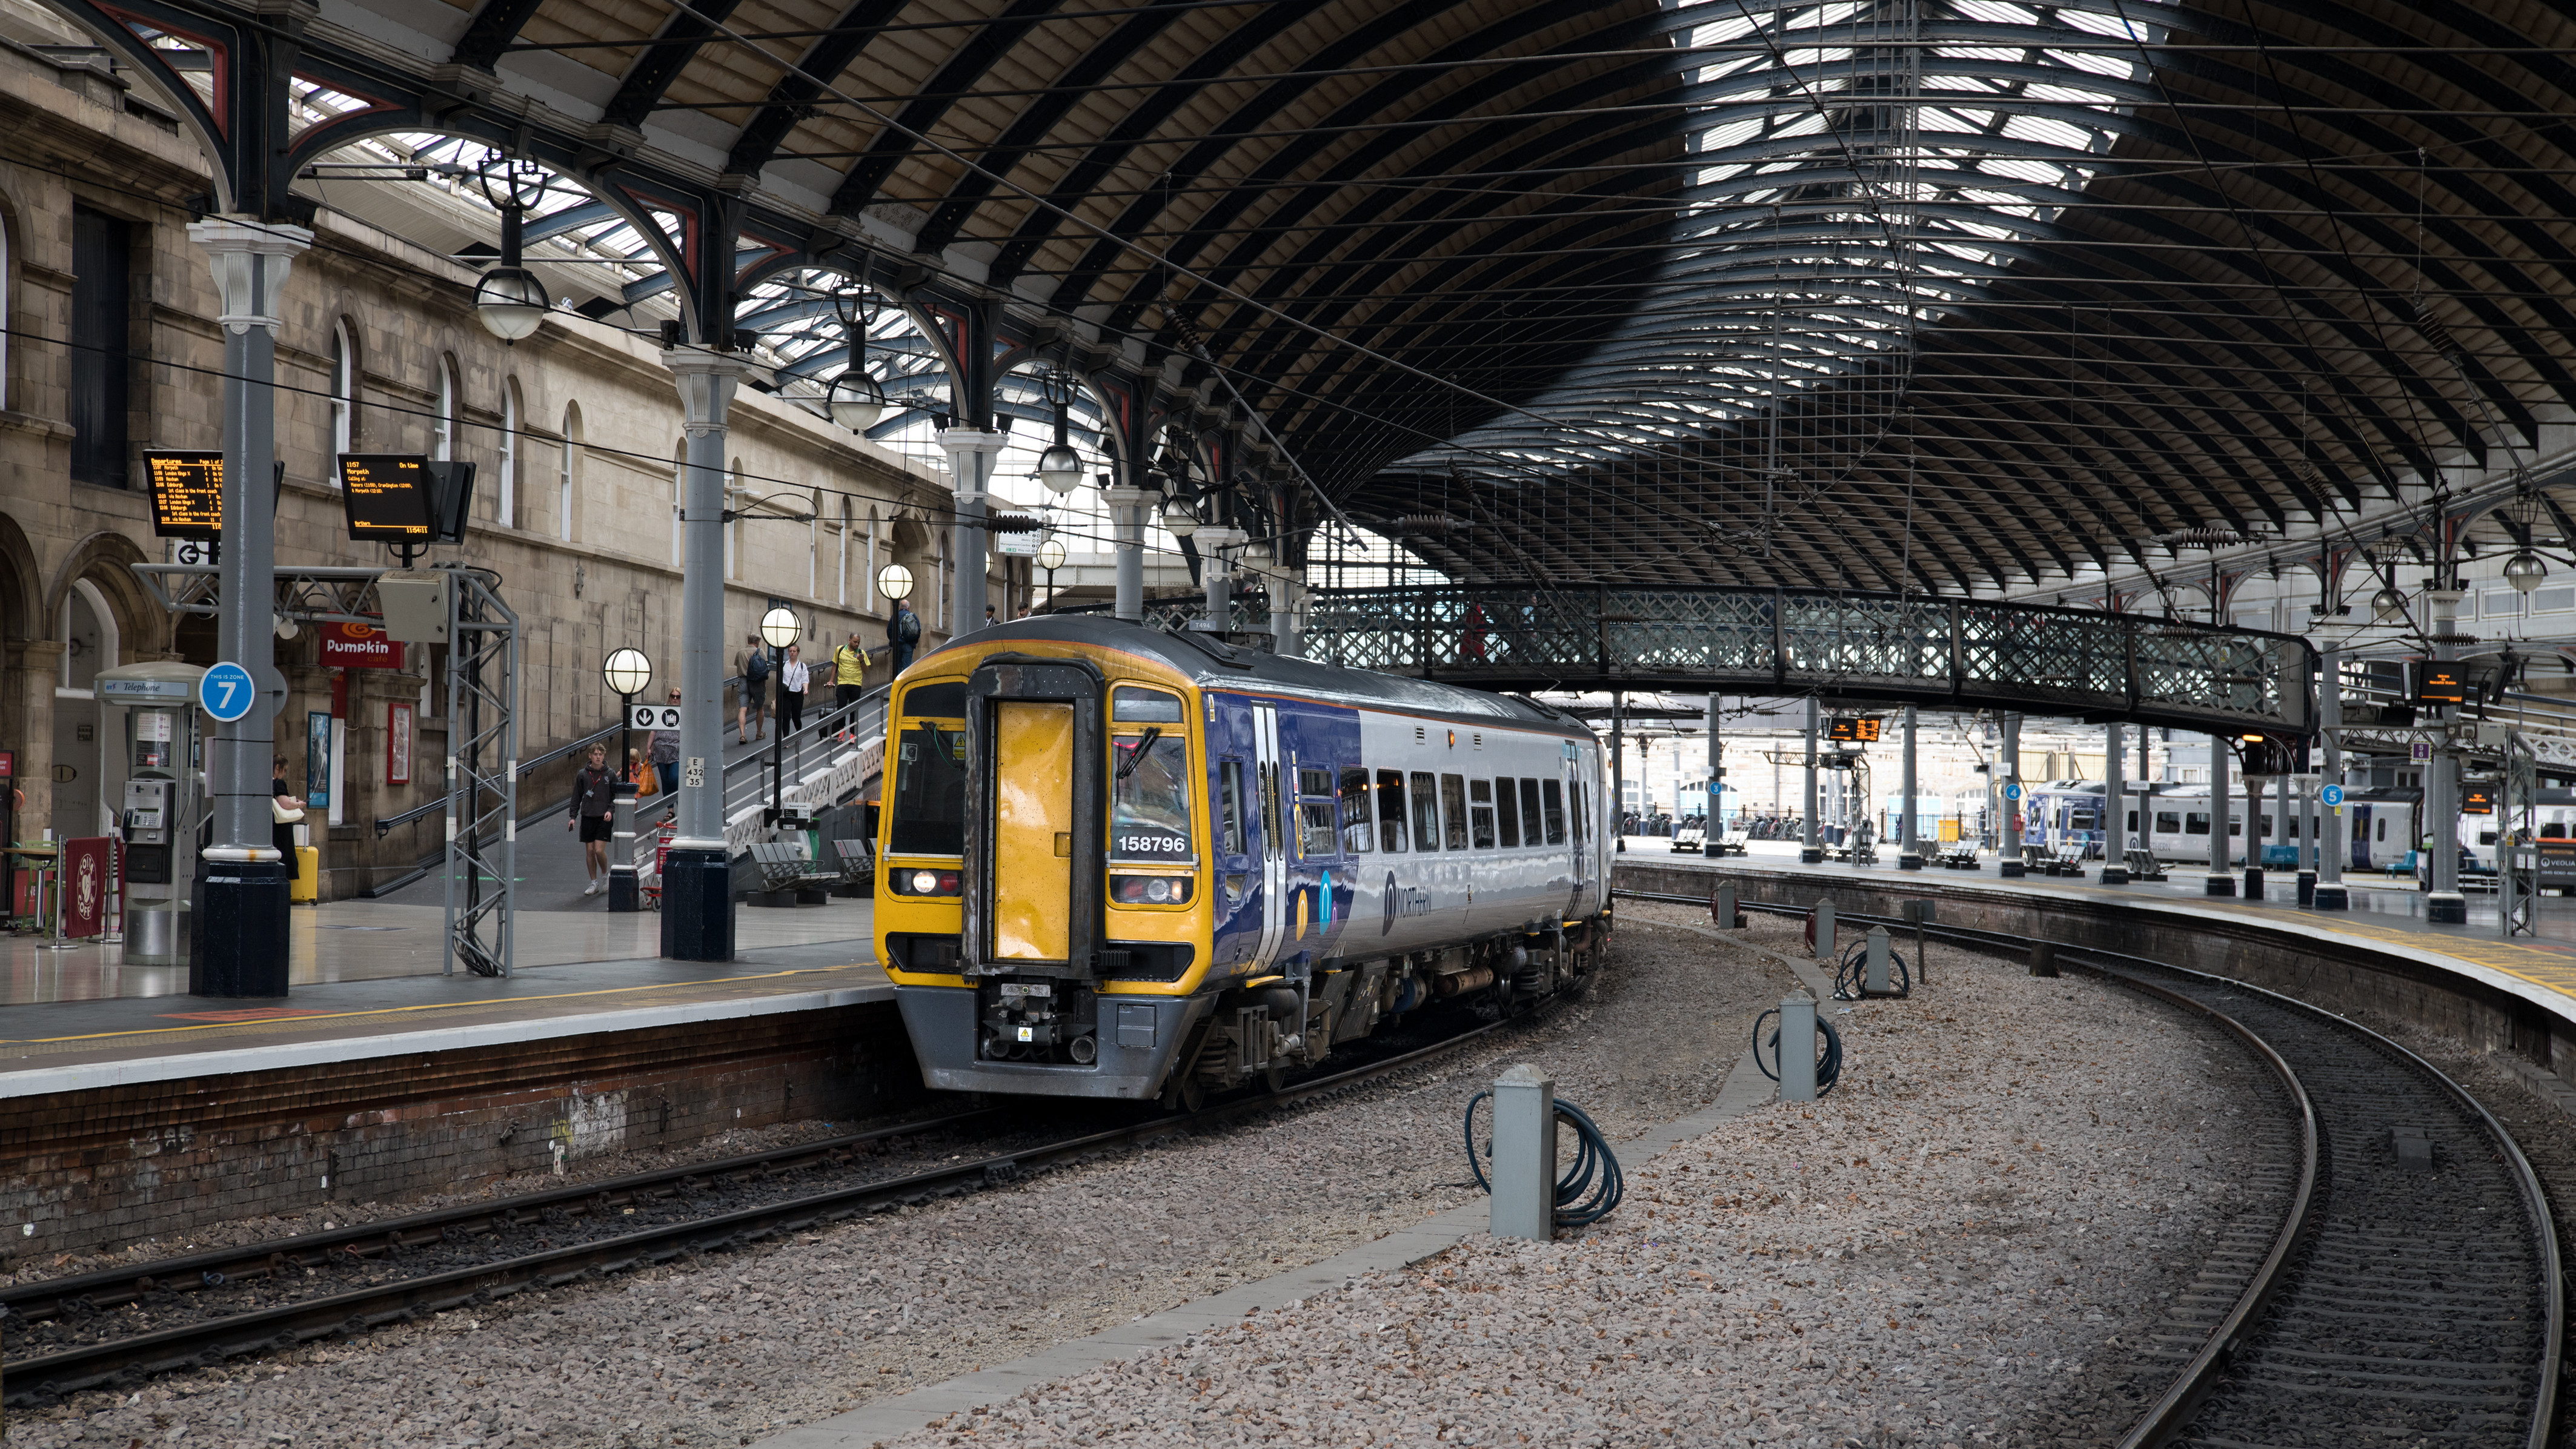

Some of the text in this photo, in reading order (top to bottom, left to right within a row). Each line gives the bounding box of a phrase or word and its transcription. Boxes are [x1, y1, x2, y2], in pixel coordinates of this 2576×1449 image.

[327, 639, 389, 654] Pumpkin
[124, 683, 160, 693] Telephone
[218, 682, 236, 708] 7
[2010, 789, 2017, 797] 4
[2329, 791, 2337, 802] 5
[1119, 837, 1185, 852] 158796
[1397, 886, 1432, 919] NORTHERN
[1098, 983, 1106, 992] 2
